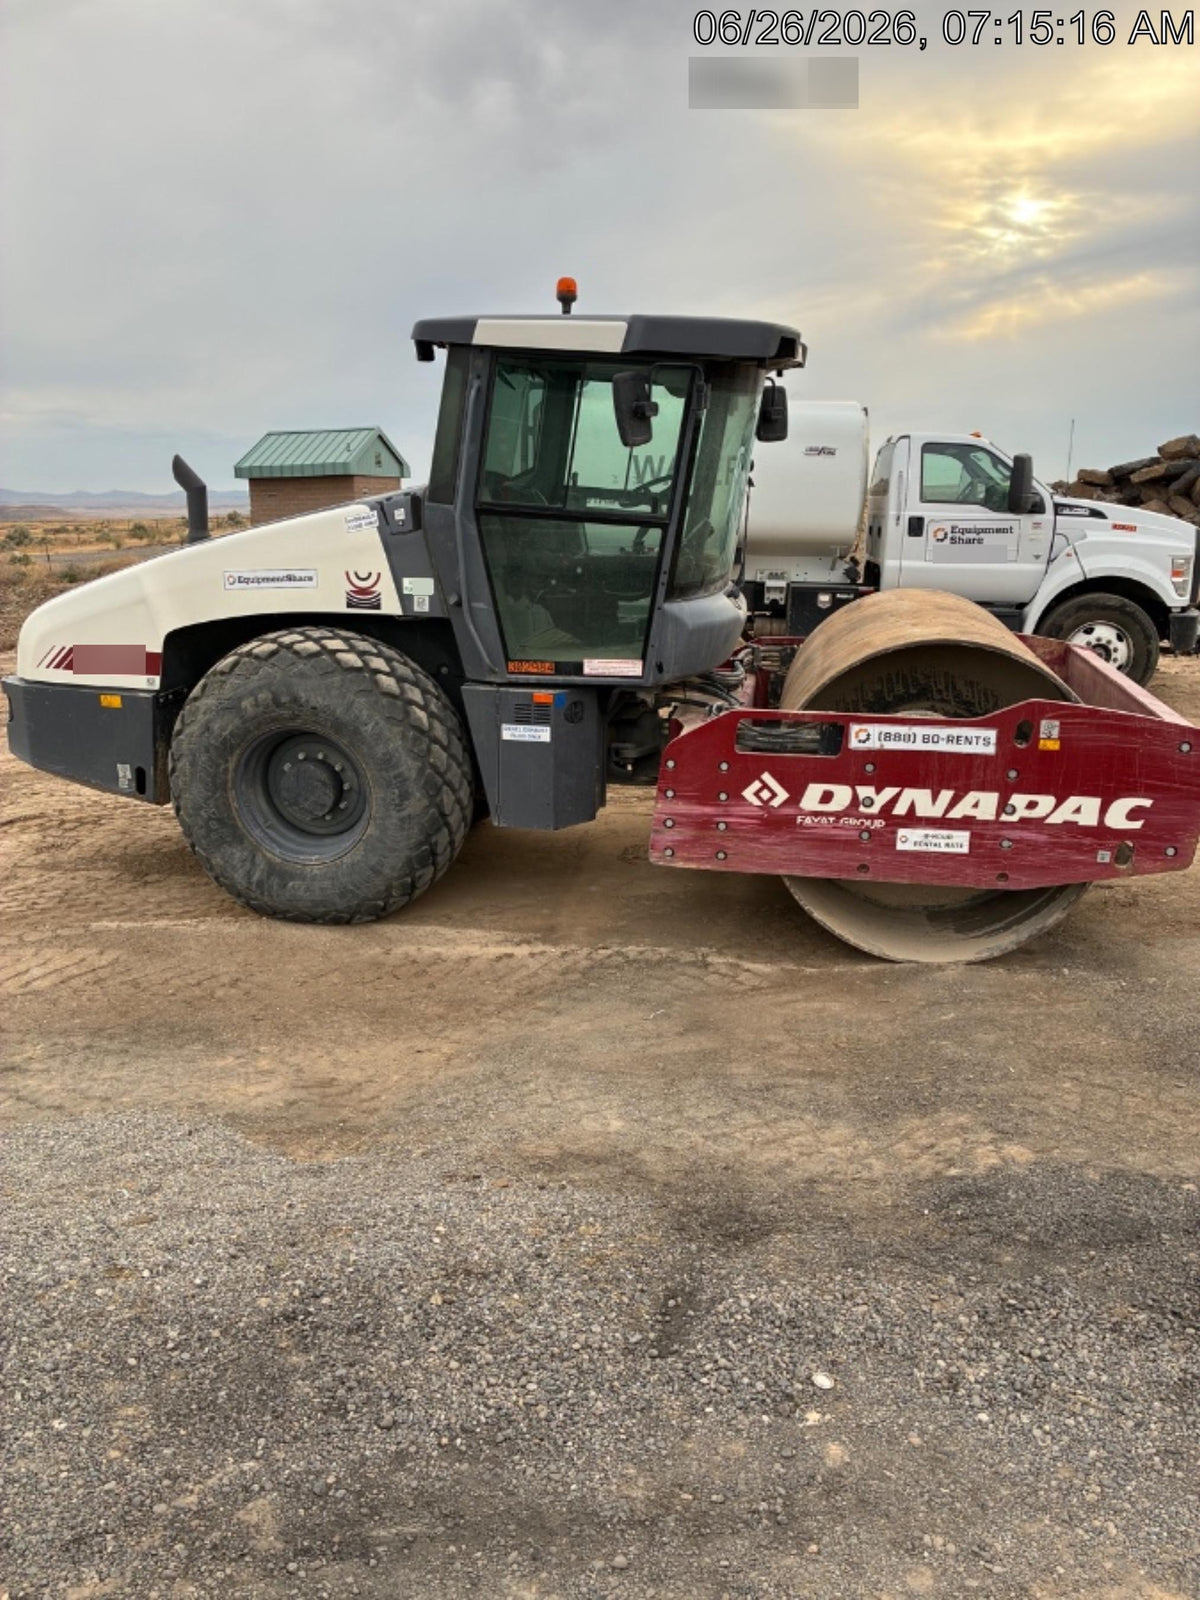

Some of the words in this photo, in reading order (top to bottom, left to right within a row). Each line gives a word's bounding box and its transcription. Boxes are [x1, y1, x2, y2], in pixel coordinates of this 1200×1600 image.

[950, 525, 1014, 536] Equipment
[949, 536, 984, 545] Share
[237, 574, 314, 585] EquipmentShare
[799, 783, 1154, 830] DYNAPAC
[796, 815, 836, 825] FAYAT
[840, 817, 886, 830] GROUP
